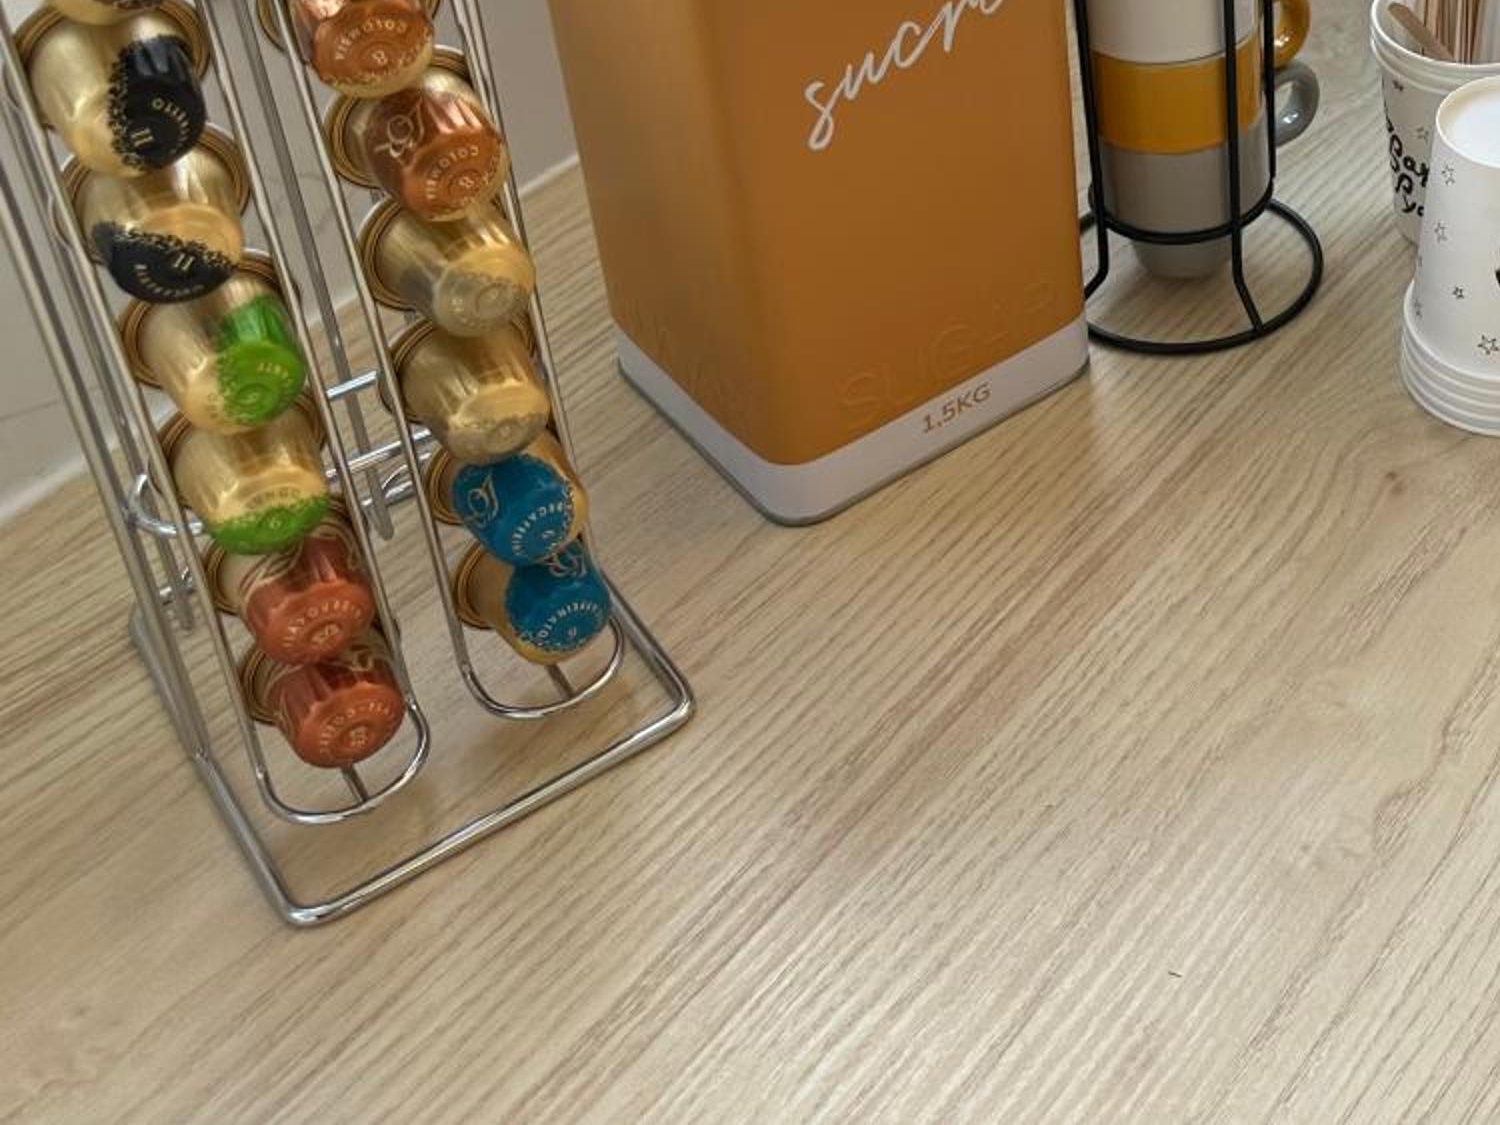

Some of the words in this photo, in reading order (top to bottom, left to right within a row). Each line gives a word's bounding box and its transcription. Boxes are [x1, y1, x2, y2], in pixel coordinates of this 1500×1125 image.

[335, 19, 408, 62] COLOMBIA
[426, 144, 480, 200] COLOMBIA
[920, 381, 991, 434] 1.5KG
